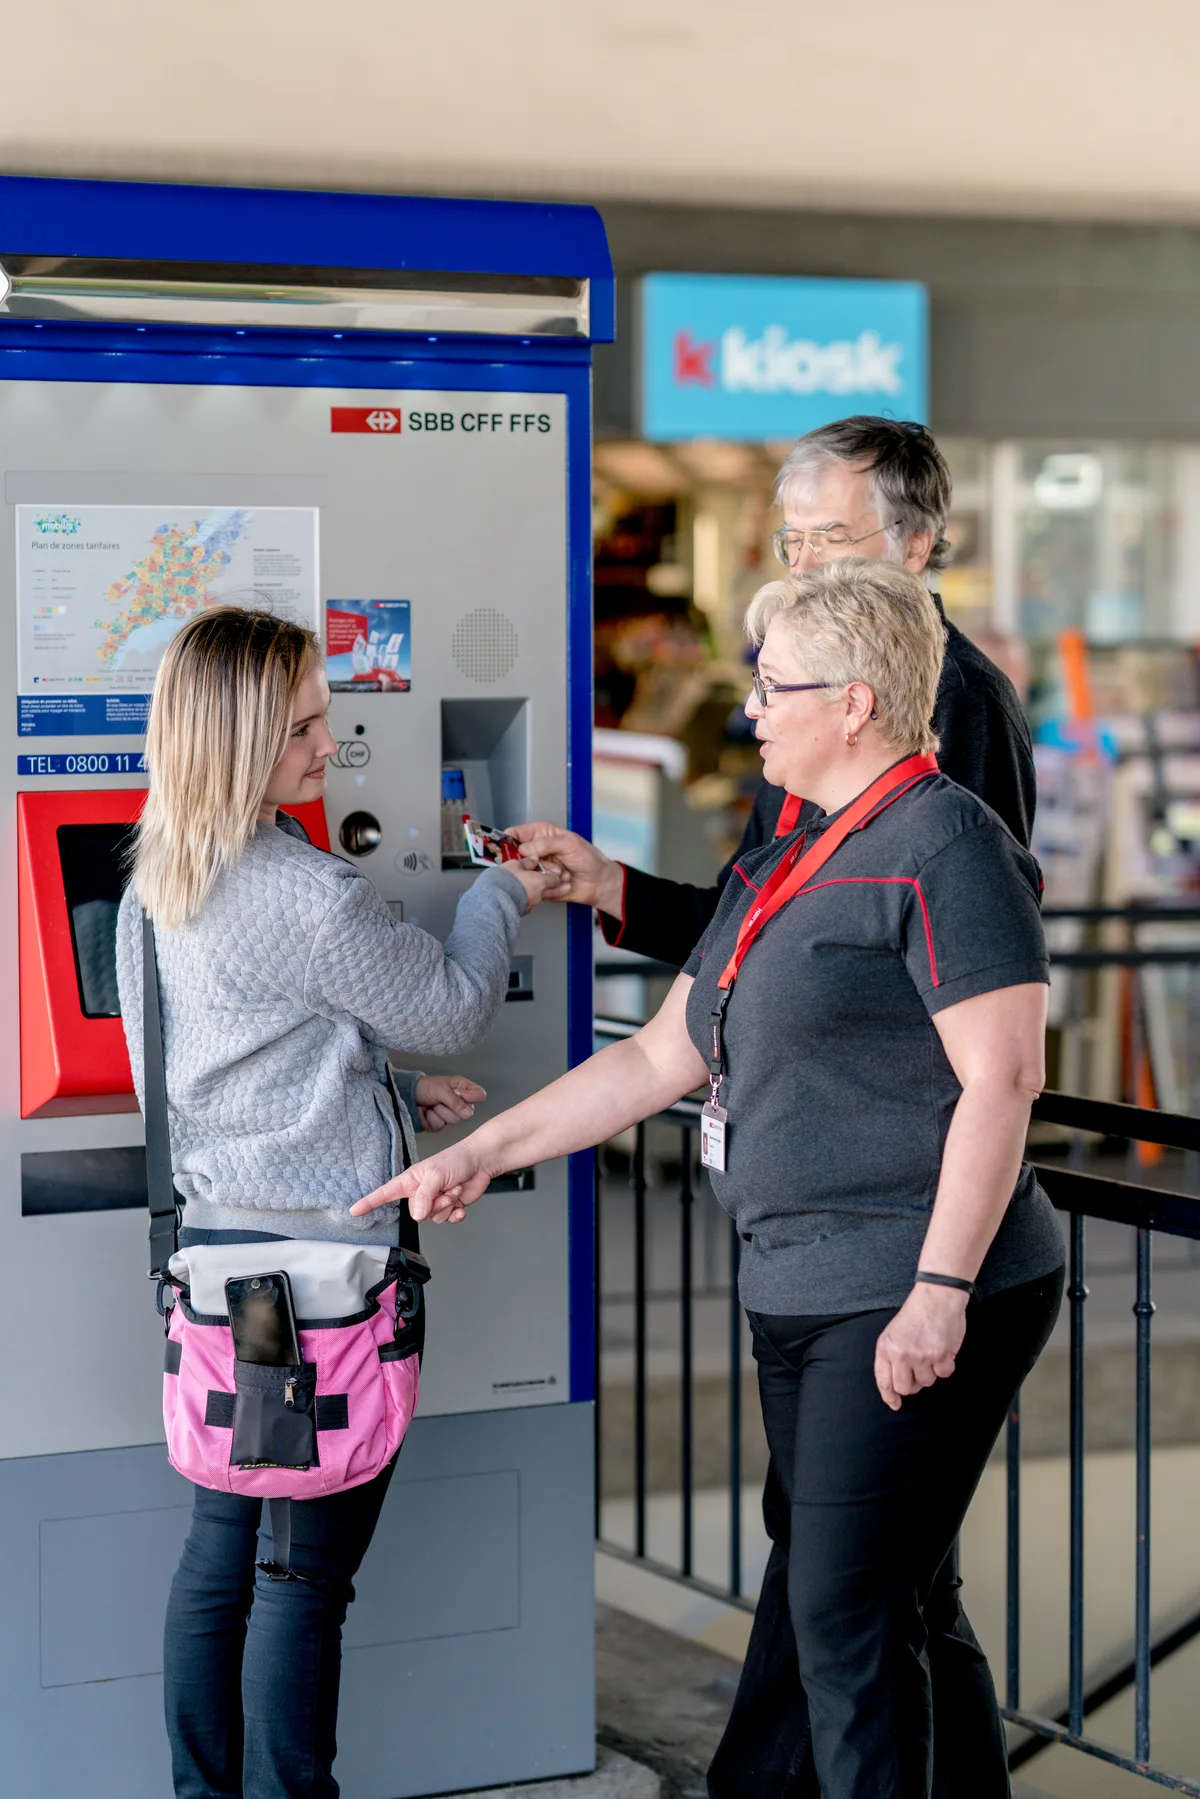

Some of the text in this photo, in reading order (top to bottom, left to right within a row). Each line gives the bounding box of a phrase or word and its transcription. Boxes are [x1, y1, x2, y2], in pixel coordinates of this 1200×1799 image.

[674, 323, 903, 396] k kiosk
[408, 412, 551, 433] SBB CFF FFS
[41, 519, 74, 531] mobilis
[31, 541, 48, 550] Plan
[50, 541, 60, 550] de
[86, 541, 120, 550] tarifaires
[27, 757, 56, 773] TEL
[66, 755, 109, 772] 0800
[116, 755, 129, 771] 11
